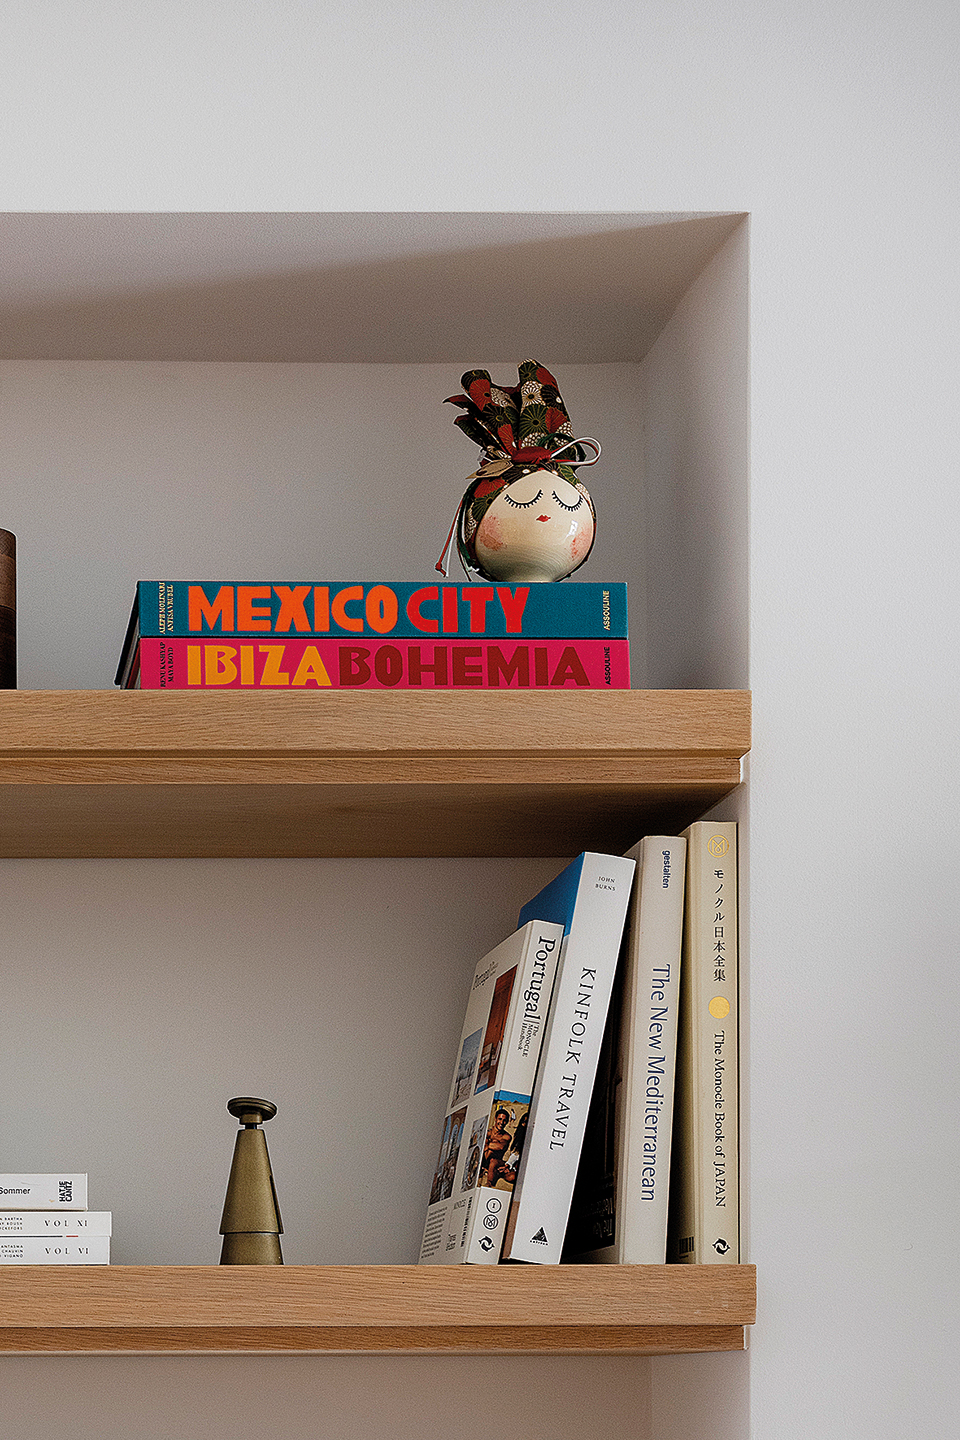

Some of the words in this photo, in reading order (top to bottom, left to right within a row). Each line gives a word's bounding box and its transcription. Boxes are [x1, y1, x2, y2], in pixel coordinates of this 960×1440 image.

[188, 585, 398, 634] MEXICO
[406, 586, 530, 633] CITY
[603, 590, 611, 630] ASSOULINE
[187, 644, 332, 687] IBIZA
[338, 644, 591, 688] BOHEMIA
[604, 647, 612, 686] ASSOULINE
[595, 884, 616, 892] BURNS
[662, 850, 671, 889] gestalten
[713, 869, 726, 982] モノクル日本全集
[524, 936, 556, 1020] Portugal
[651, 963, 671, 1001] The
[565, 967, 597, 1065] KINFOLK
[648, 1006, 668, 1050] New
[518, 1022, 528, 1051] Handbook
[522, 1024, 534, 1057] MONOCLE
[714, 1030, 725, 1055] The
[714, 1058, 725, 1109] Monocle
[549, 1073, 577, 1150] TRAVEL
[641, 1056, 666, 1201] Mediterranean
[714, 1112, 725, 1142] Book
[714, 1145, 725, 1156] of
[58, 1181, 66, 1202] HATJE
[713, 1162, 726, 1207] JAPAN
[45, 1247, 70, 1255] VOL
[78, 1247, 89, 1255] VI
